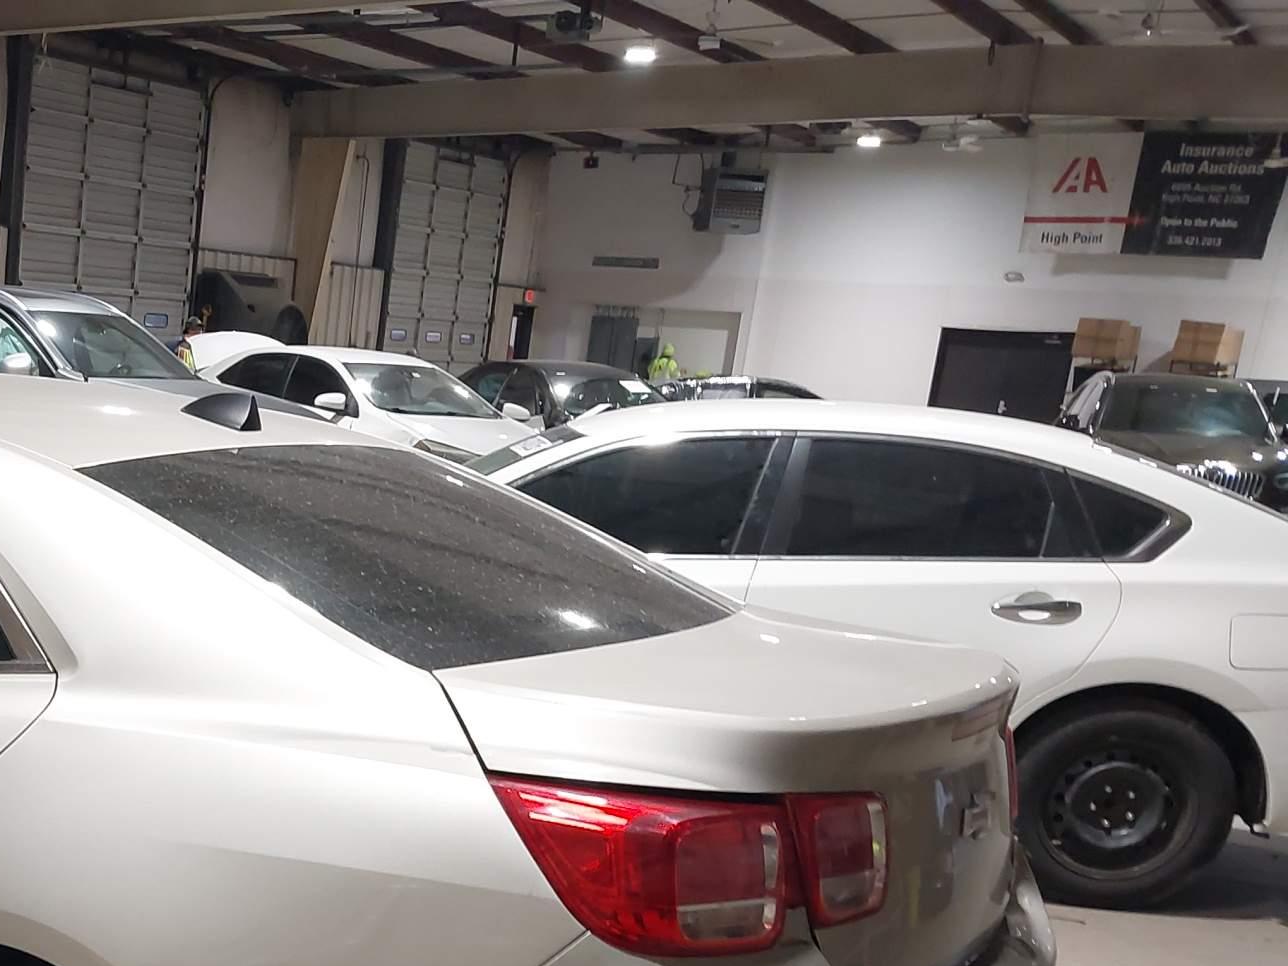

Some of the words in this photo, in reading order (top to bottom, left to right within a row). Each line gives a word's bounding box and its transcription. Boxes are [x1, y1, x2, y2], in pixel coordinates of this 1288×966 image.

[1179, 142, 1254, 157] Insurance
[1160, 159, 1195, 174] Auto
[1197, 159, 1264, 175] Auctions
[1184, 217, 1193, 226] to
[1194, 217, 1209, 227] the
[1040, 231, 1069, 246] High
[1073, 231, 1103, 243] Point
